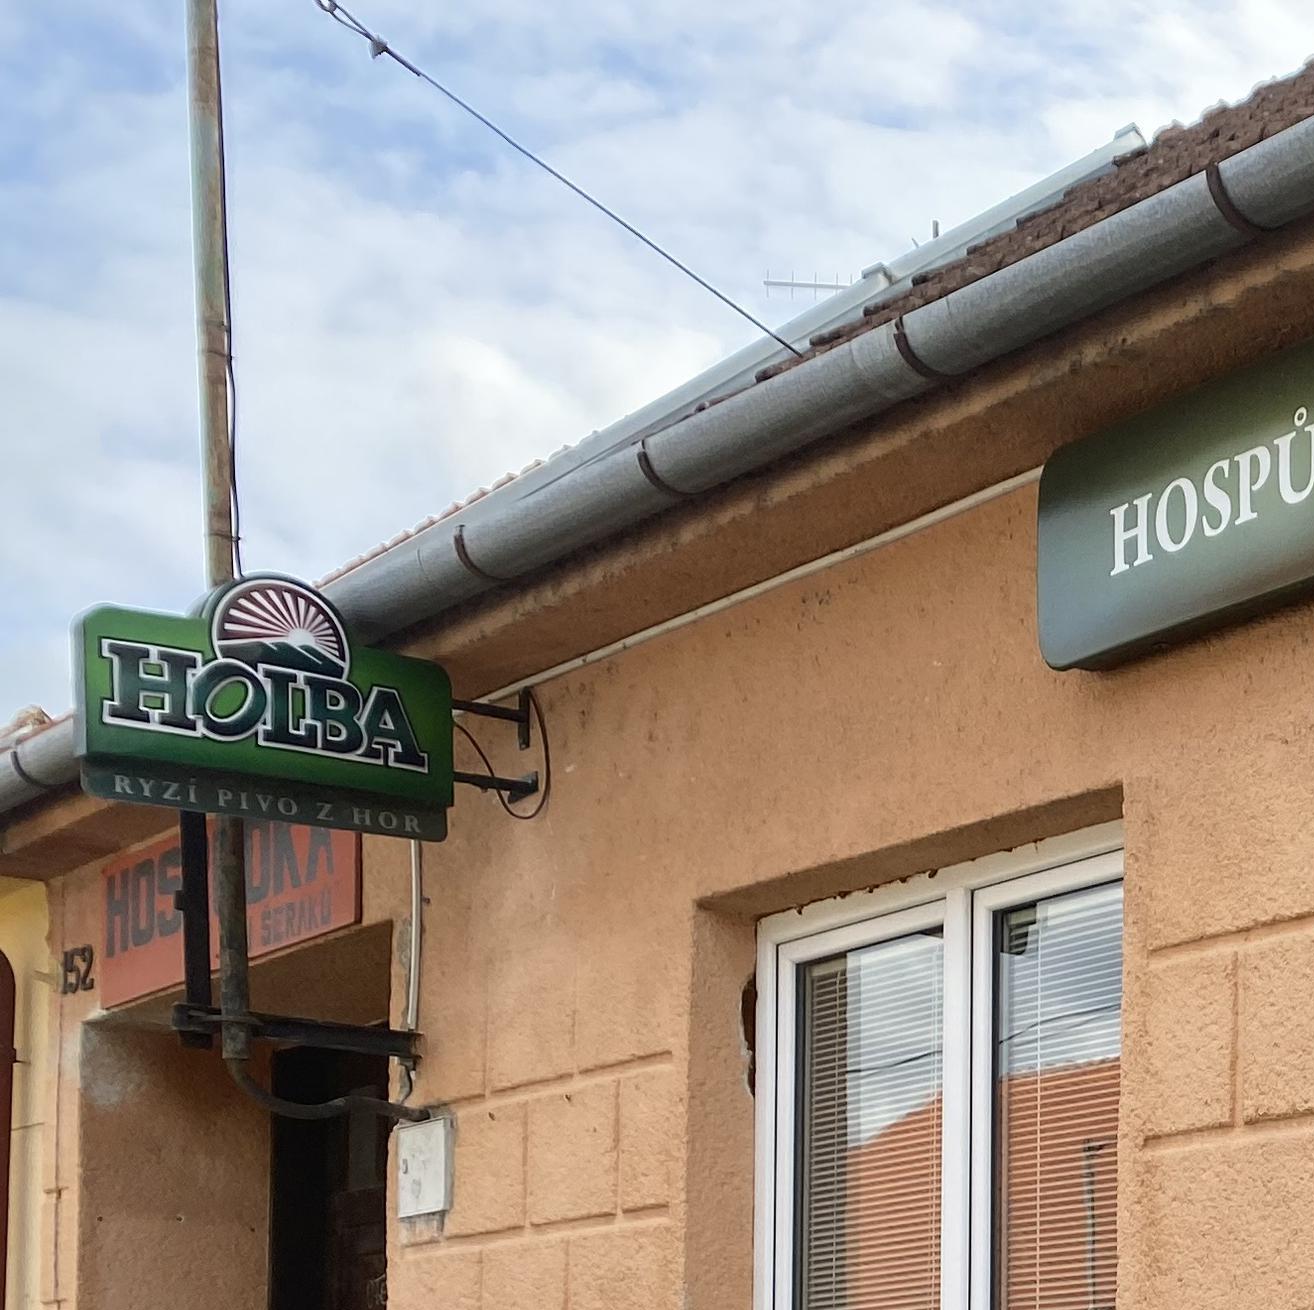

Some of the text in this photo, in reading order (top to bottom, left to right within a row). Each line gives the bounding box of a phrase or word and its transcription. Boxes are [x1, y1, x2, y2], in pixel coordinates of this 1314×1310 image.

[101, 638, 428, 773] HOLBA
[113, 774, 421, 834] RYZÍ PIVO Z HOR
[105, 820, 334, 958] HOSDKA
